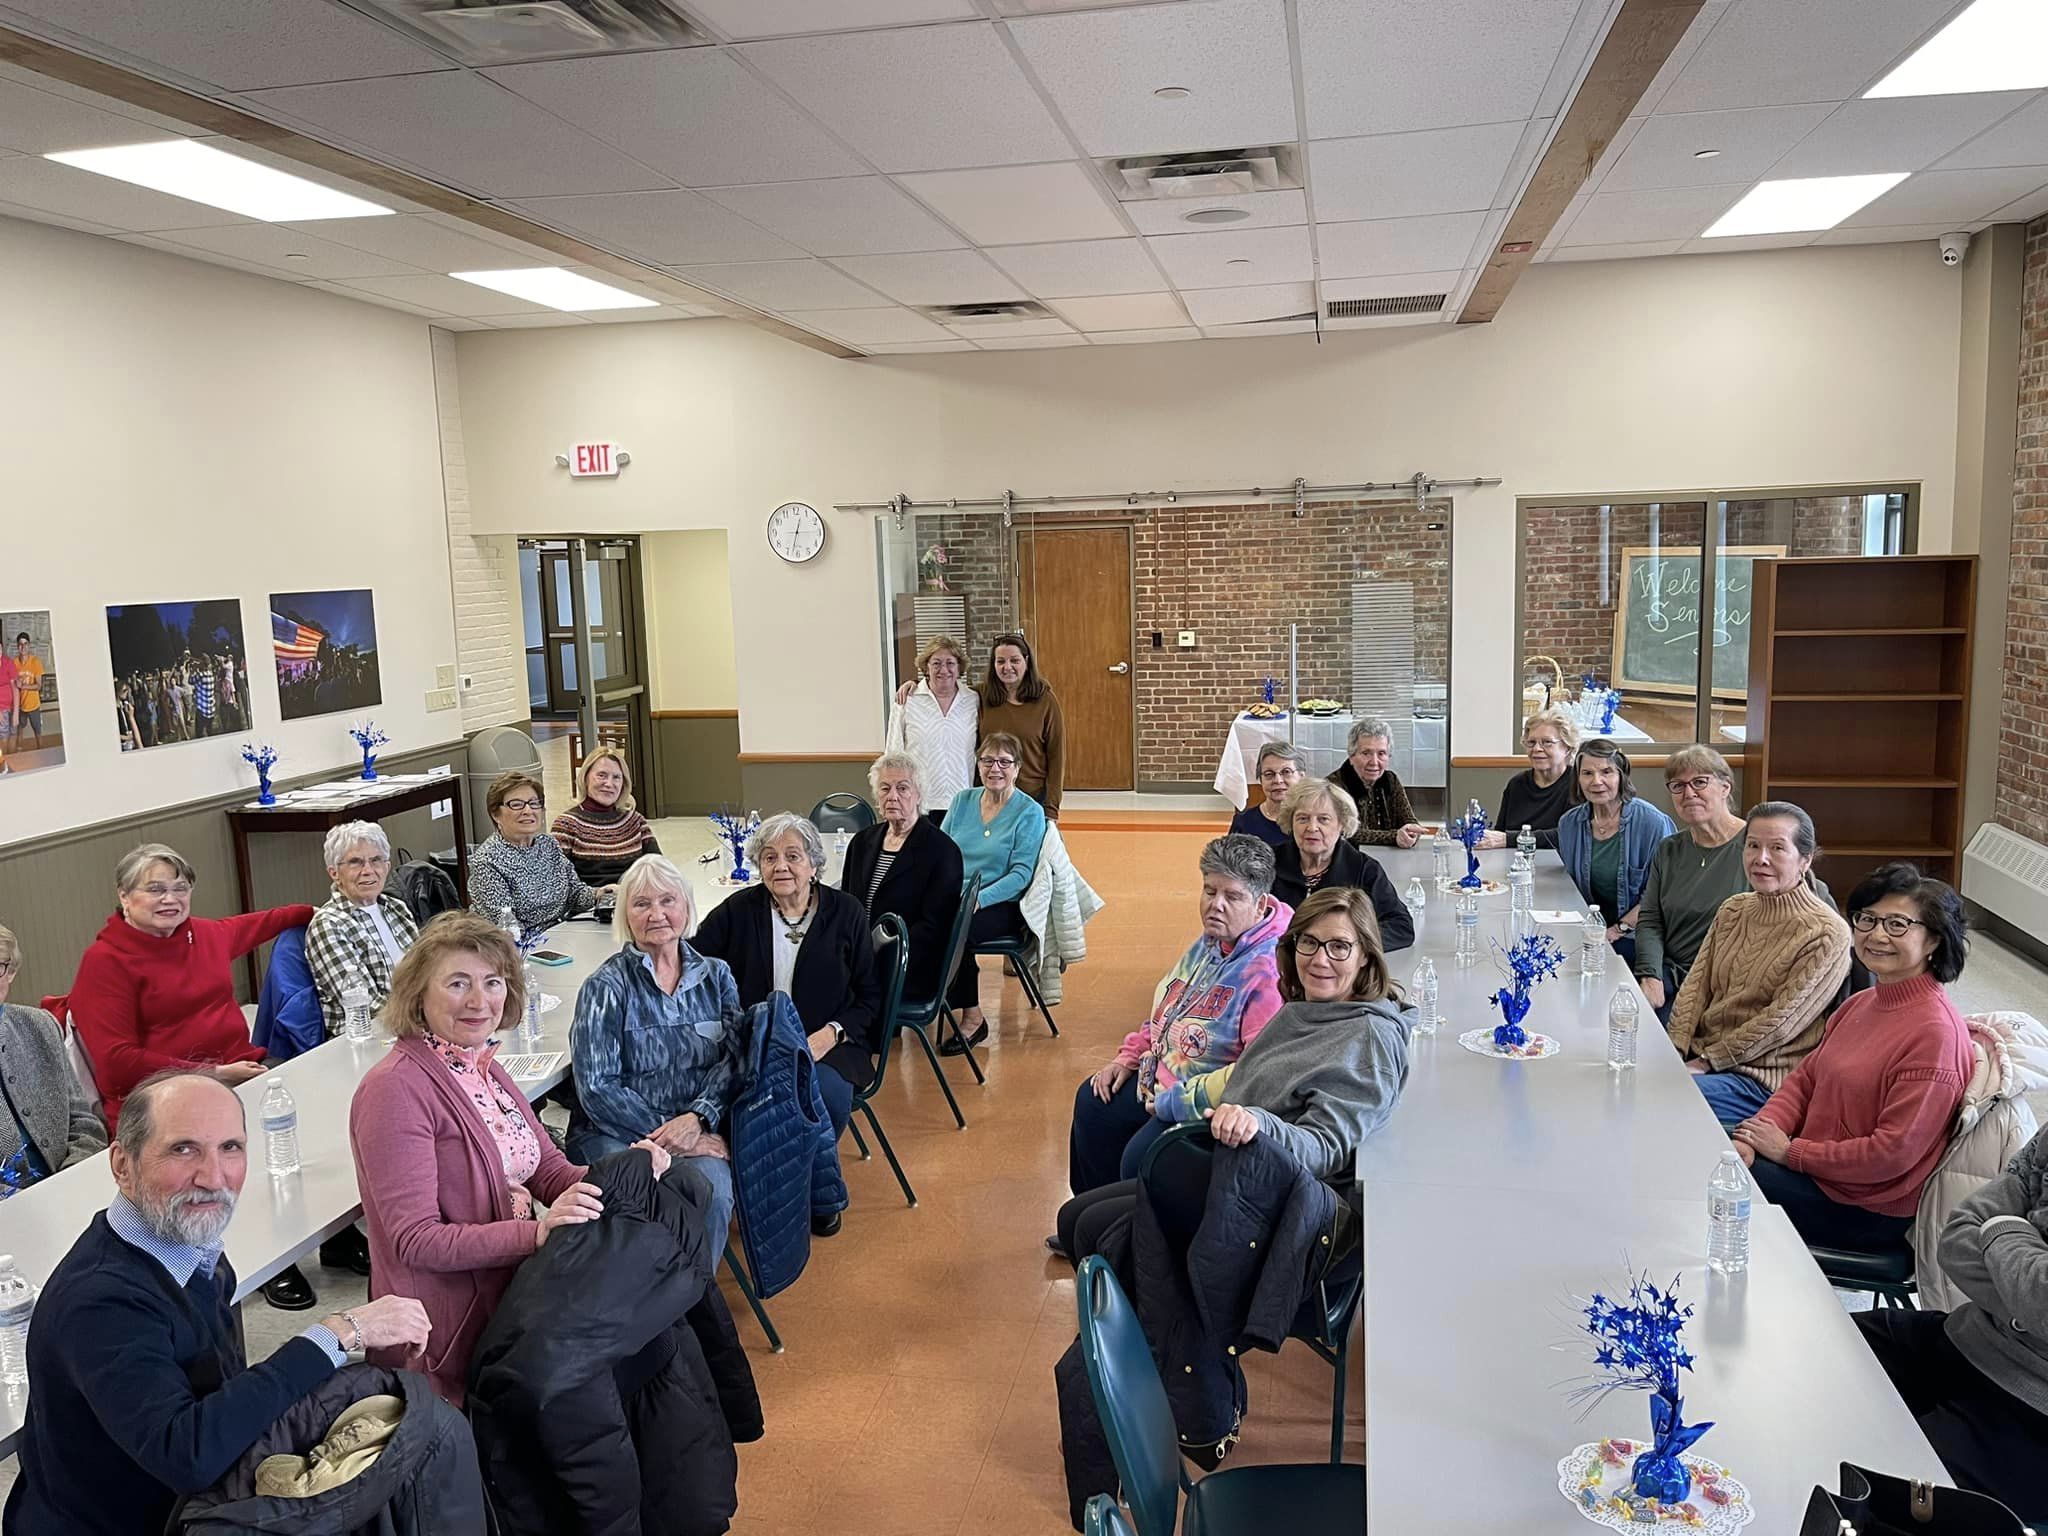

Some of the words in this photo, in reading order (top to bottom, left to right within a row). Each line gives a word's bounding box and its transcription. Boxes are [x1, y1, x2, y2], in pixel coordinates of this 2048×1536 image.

[576, 444, 610, 473] EXIT
[1634, 561, 1747, 598] Welcme
[1645, 601, 1750, 632] Senrs
